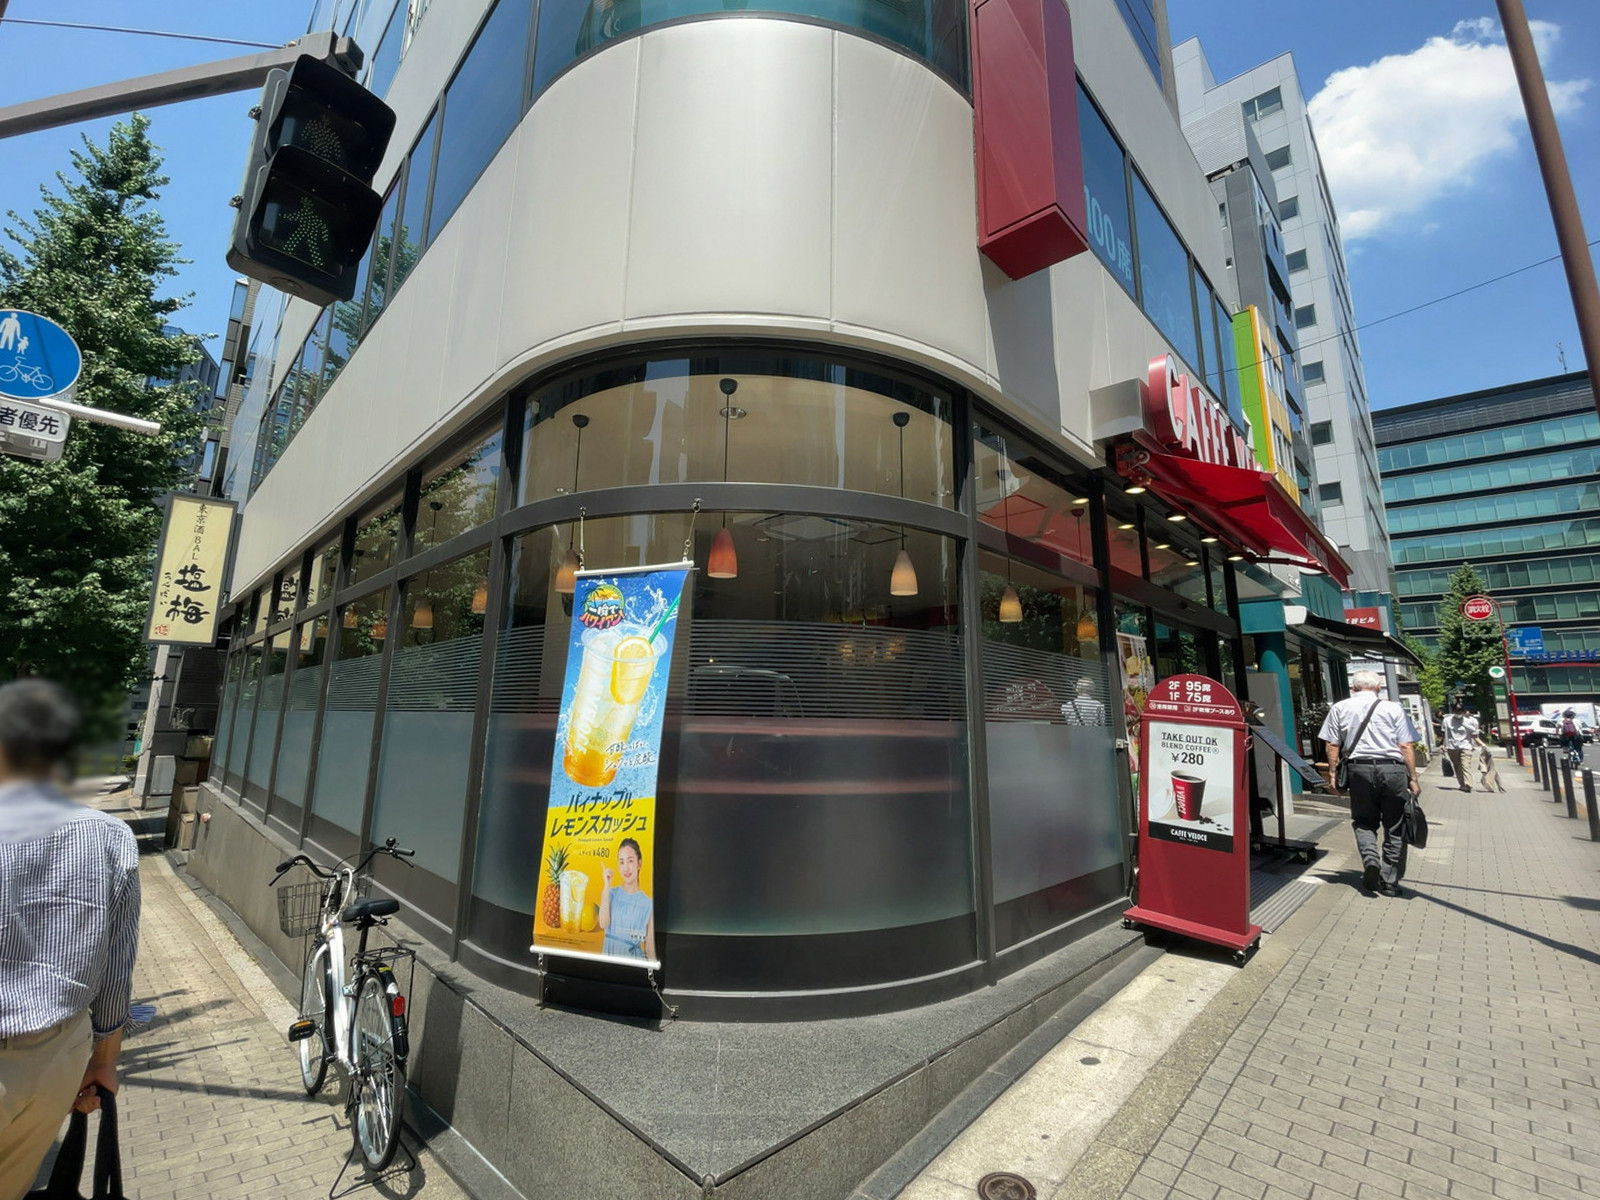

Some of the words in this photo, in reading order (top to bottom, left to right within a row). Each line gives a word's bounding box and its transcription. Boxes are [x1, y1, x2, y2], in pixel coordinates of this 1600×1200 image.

[0, 406, 60, 436] 者優先
[165, 563, 212, 625] 塩梅
[1168, 680, 1180, 690] 2F
[1185, 681, 1211, 692] 95席
[1169, 692, 1180, 701] 1F
[1185, 692, 1211, 703] 75席
[1161, 732, 1184, 742] TAKE
[1185, 734, 1203, 744] OUT
[1205, 736, 1218, 746] OK
[1161, 741, 1184, 750] BLEND
[1185, 744, 1212, 753] COFFEE
[566, 788, 634, 813] パイナップル
[550, 813, 648, 838] レモンスカッシュ
